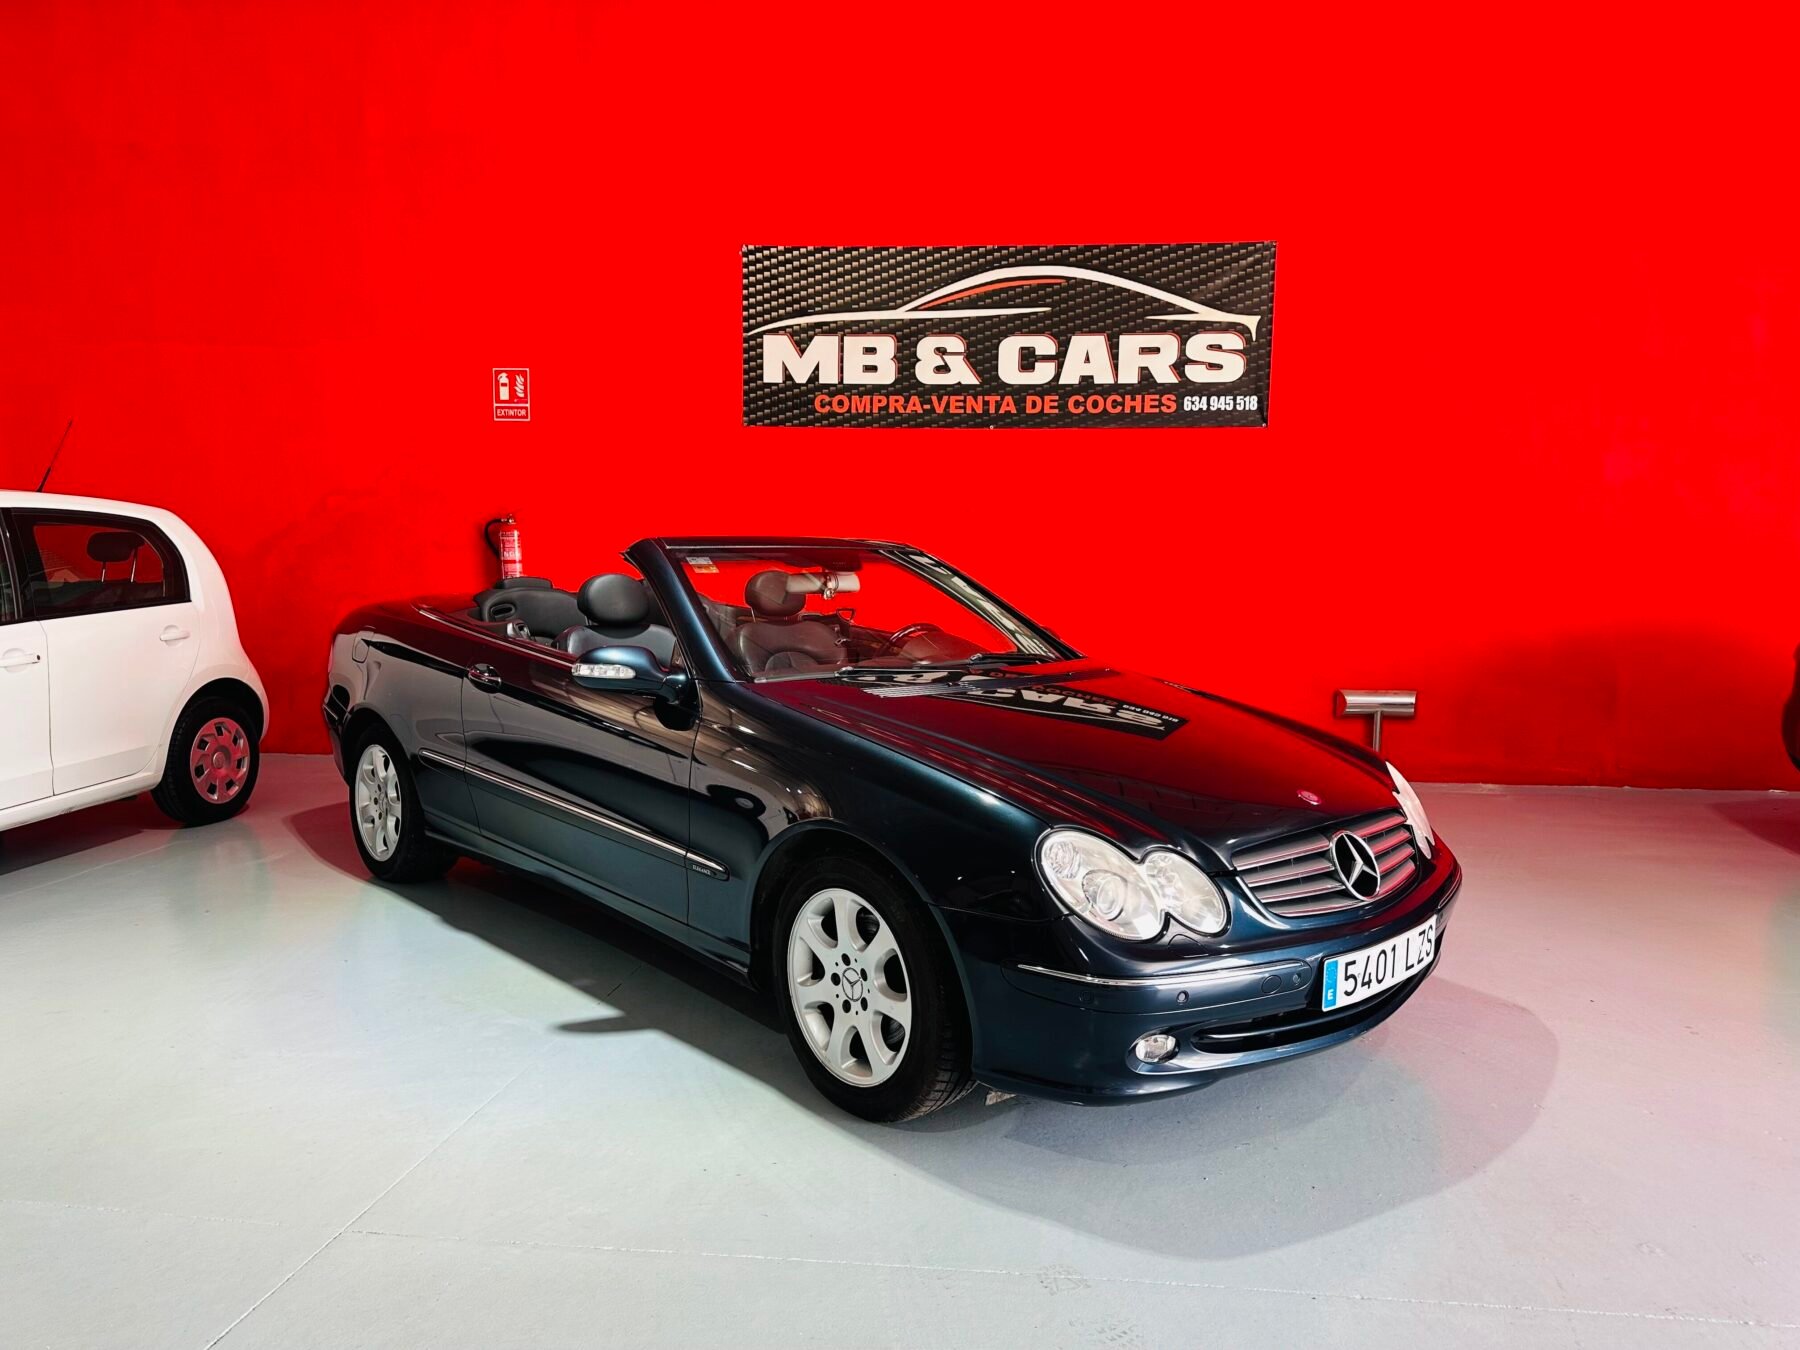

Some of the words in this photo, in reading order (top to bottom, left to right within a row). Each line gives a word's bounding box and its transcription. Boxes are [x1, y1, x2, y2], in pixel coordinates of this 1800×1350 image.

[763, 333, 898, 384] MB
[915, 333, 982, 384] &
[998, 332, 1246, 384] CARS
[814, 394, 1017, 414] COMPRA-VENTA
[1025, 395, 1059, 413] DE
[1068, 394, 1177, 414] COCHES
[1183, 395, 1208, 411] 634
[1209, 395, 1234, 411] 945
[1235, 395, 1258, 411] 518
[1344, 944, 1396, 996] 5401
[1405, 924, 1433, 971] LZS
[1327, 989, 1334, 1000] E
